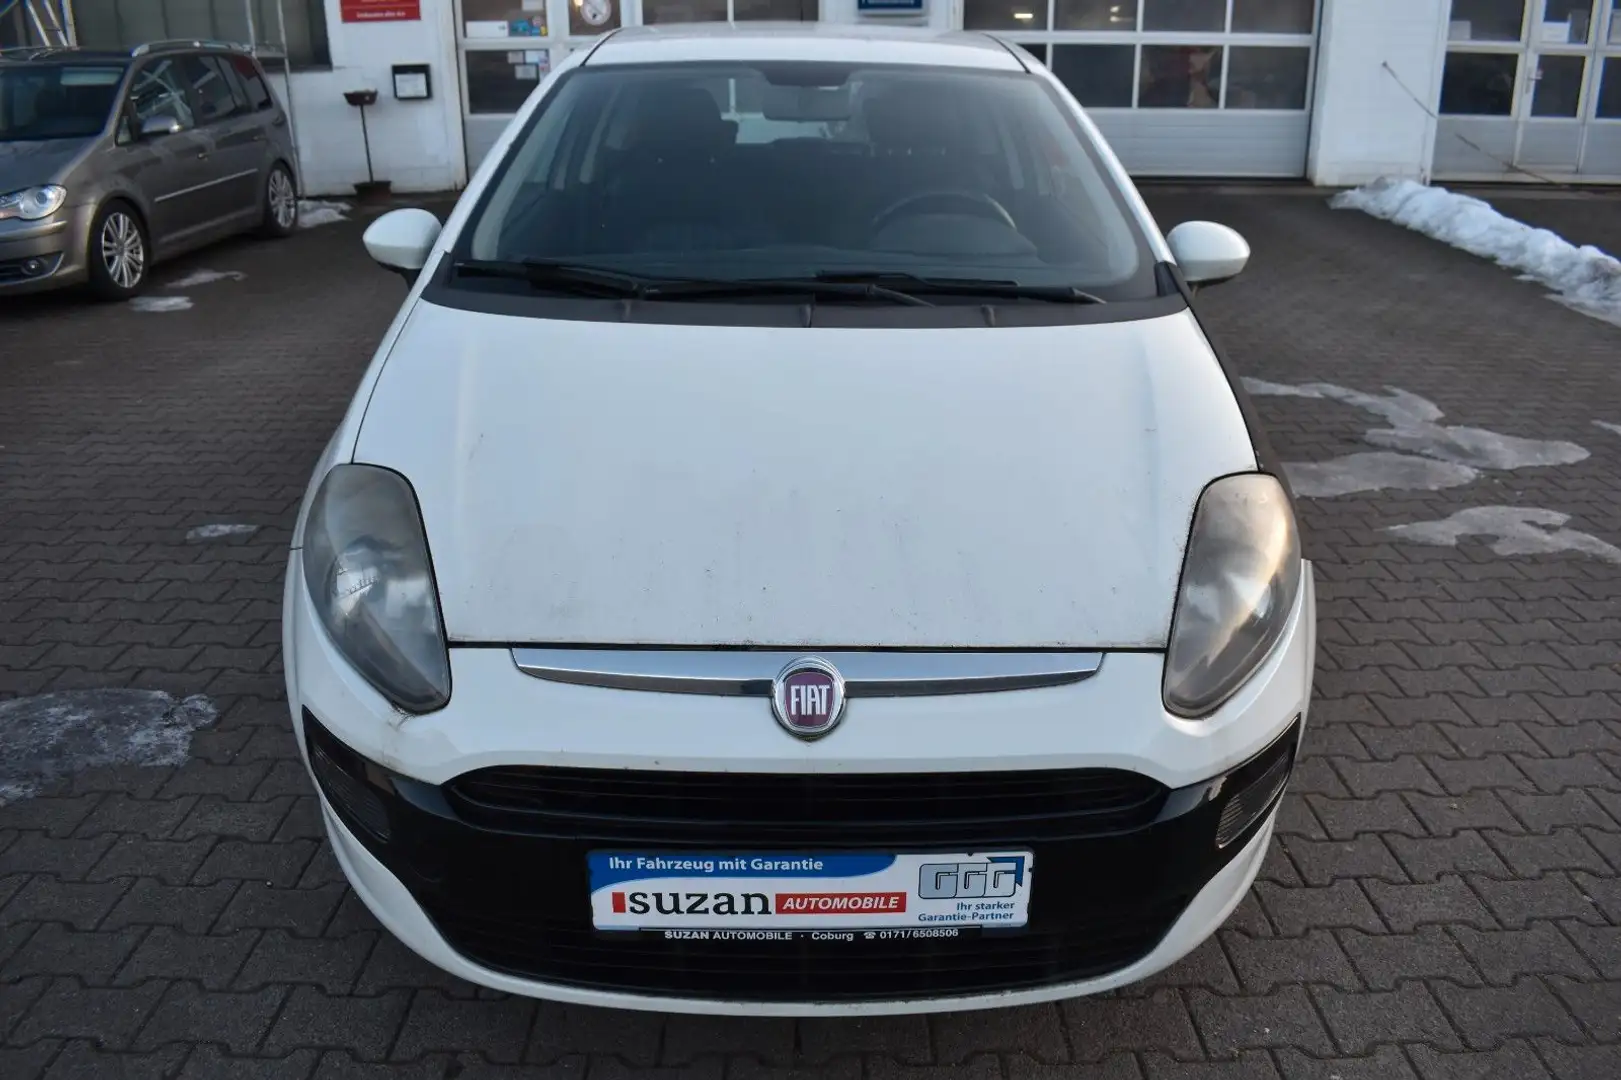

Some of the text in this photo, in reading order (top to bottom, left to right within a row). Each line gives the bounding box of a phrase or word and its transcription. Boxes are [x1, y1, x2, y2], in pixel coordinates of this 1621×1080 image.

[790, 684, 830, 715] FIAT
[609, 857, 823, 872] Ihr Fahrzeug mit Garantie
[918, 862, 1017, 899] GGG
[628, 892, 899, 915] suzan AUTOMOBILE
[956, 902, 1015, 911] Ihr starker
[918, 912, 1014, 922] Garantie-Partner
[664, 931, 710, 940] SUZAN
[712, 931, 793, 940] AUTOMOBILE
[811, 931, 854, 941] Coburg
